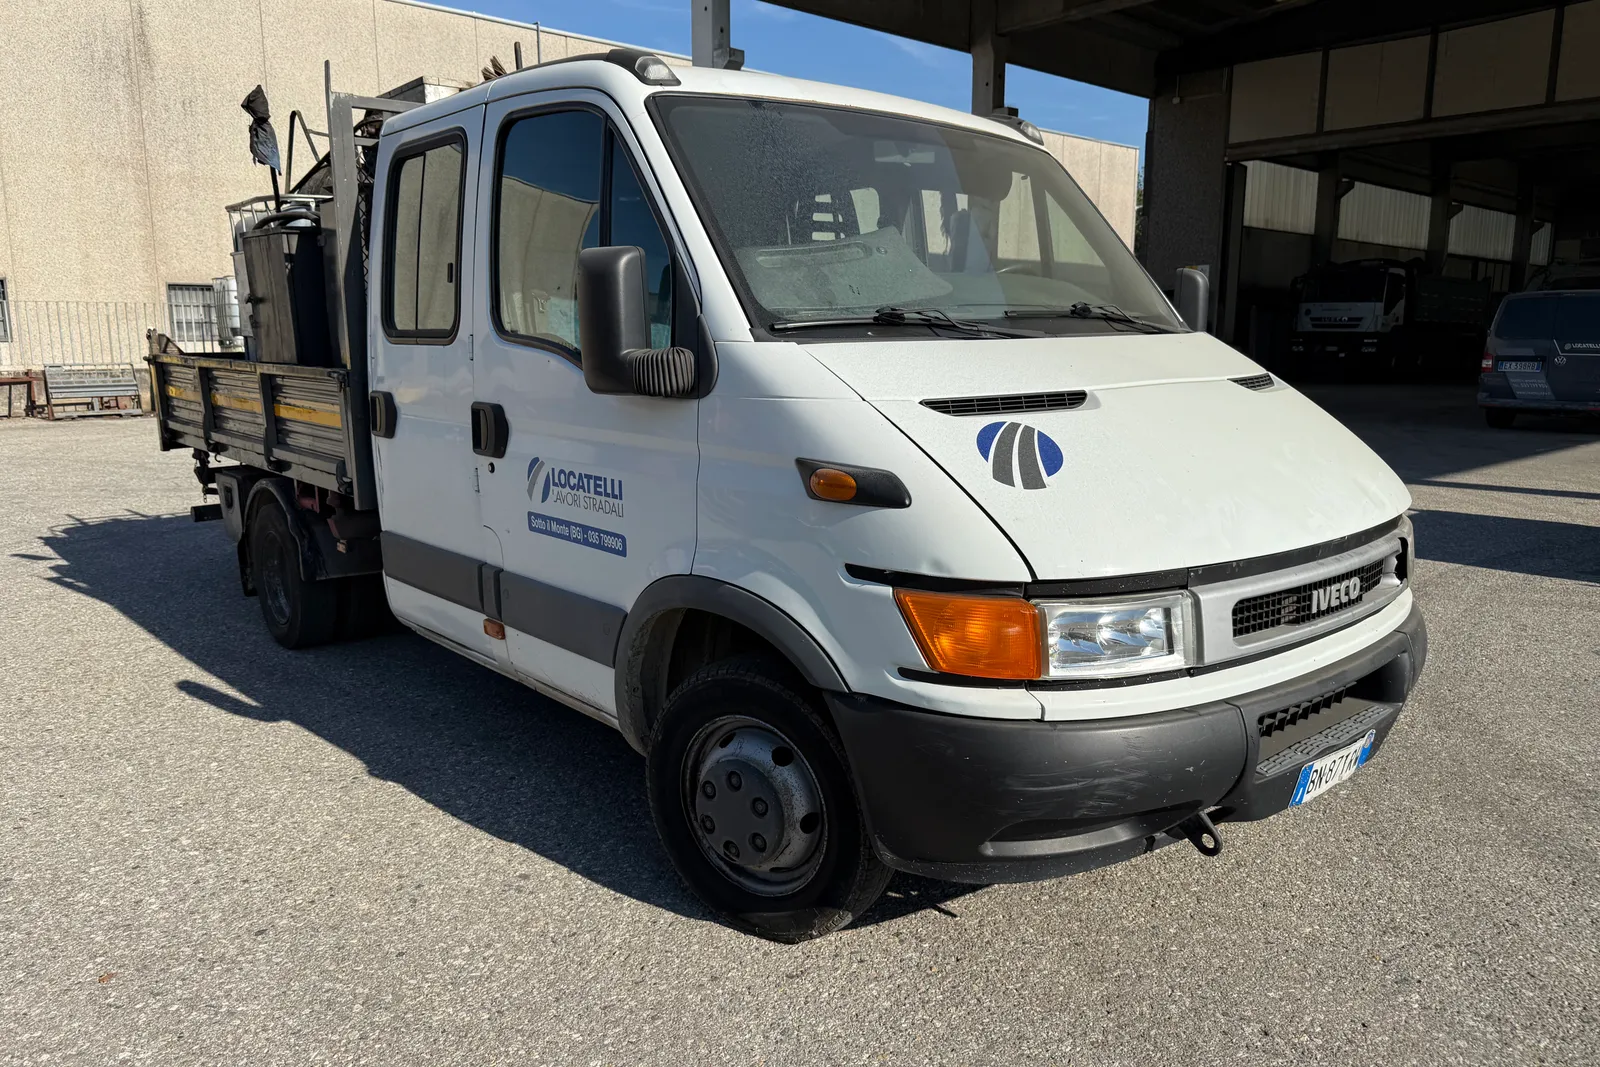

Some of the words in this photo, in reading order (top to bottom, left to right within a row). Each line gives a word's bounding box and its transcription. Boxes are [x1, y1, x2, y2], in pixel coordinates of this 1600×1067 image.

[551, 467, 623, 501] LOCATELLI
[583, 495, 624, 518] STRADALI
[530, 515, 546, 529] Sotto
[546, 519, 550, 531] il
[551, 520, 569, 536] Monte
[570, 525, 583, 542] (BG)
[587, 530, 599, 544] 035
[600, 534, 623, 551] 799906
[1311, 577, 1360, 613] IVECO
